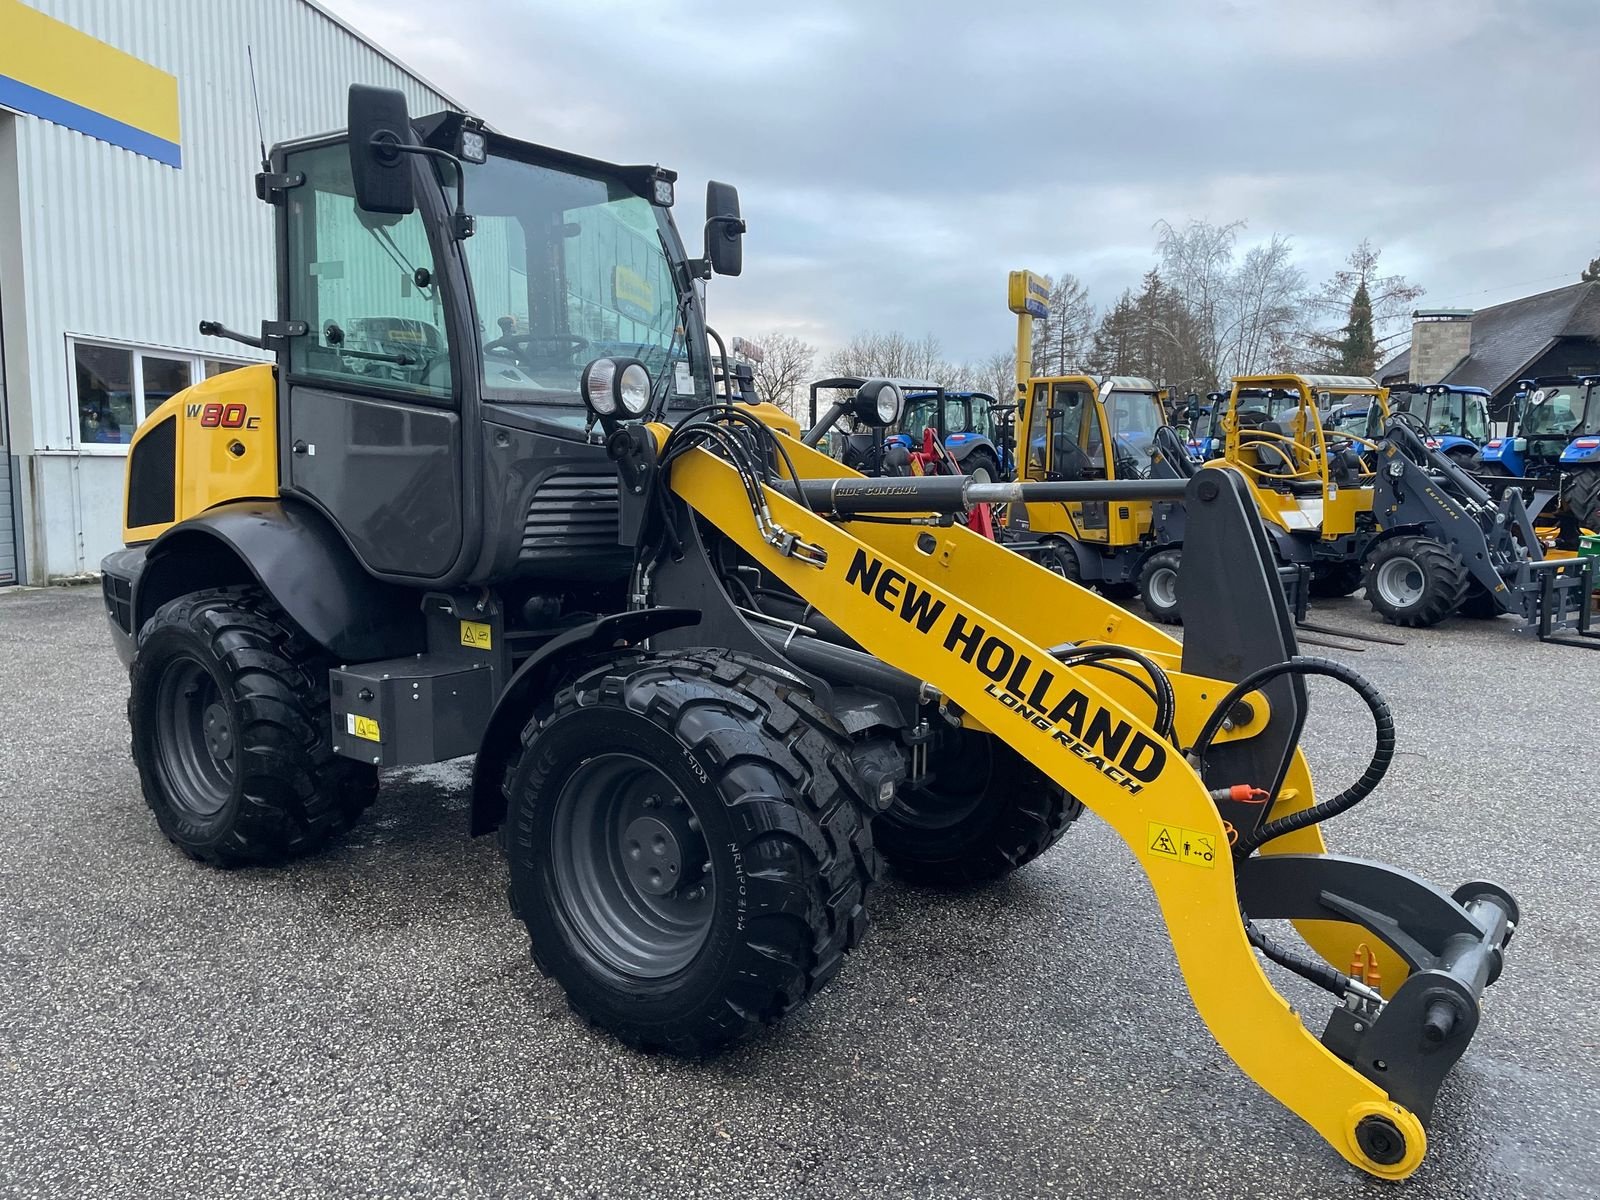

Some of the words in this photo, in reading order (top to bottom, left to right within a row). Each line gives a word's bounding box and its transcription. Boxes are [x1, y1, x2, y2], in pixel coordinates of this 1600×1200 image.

[865, 486, 918, 496] CONTROL
[845, 548, 946, 634] NEW
[943, 613, 1167, 783] HOLLAND
[984, 682, 1053, 732] LONG
[1052, 730, 1145, 797] REACH
